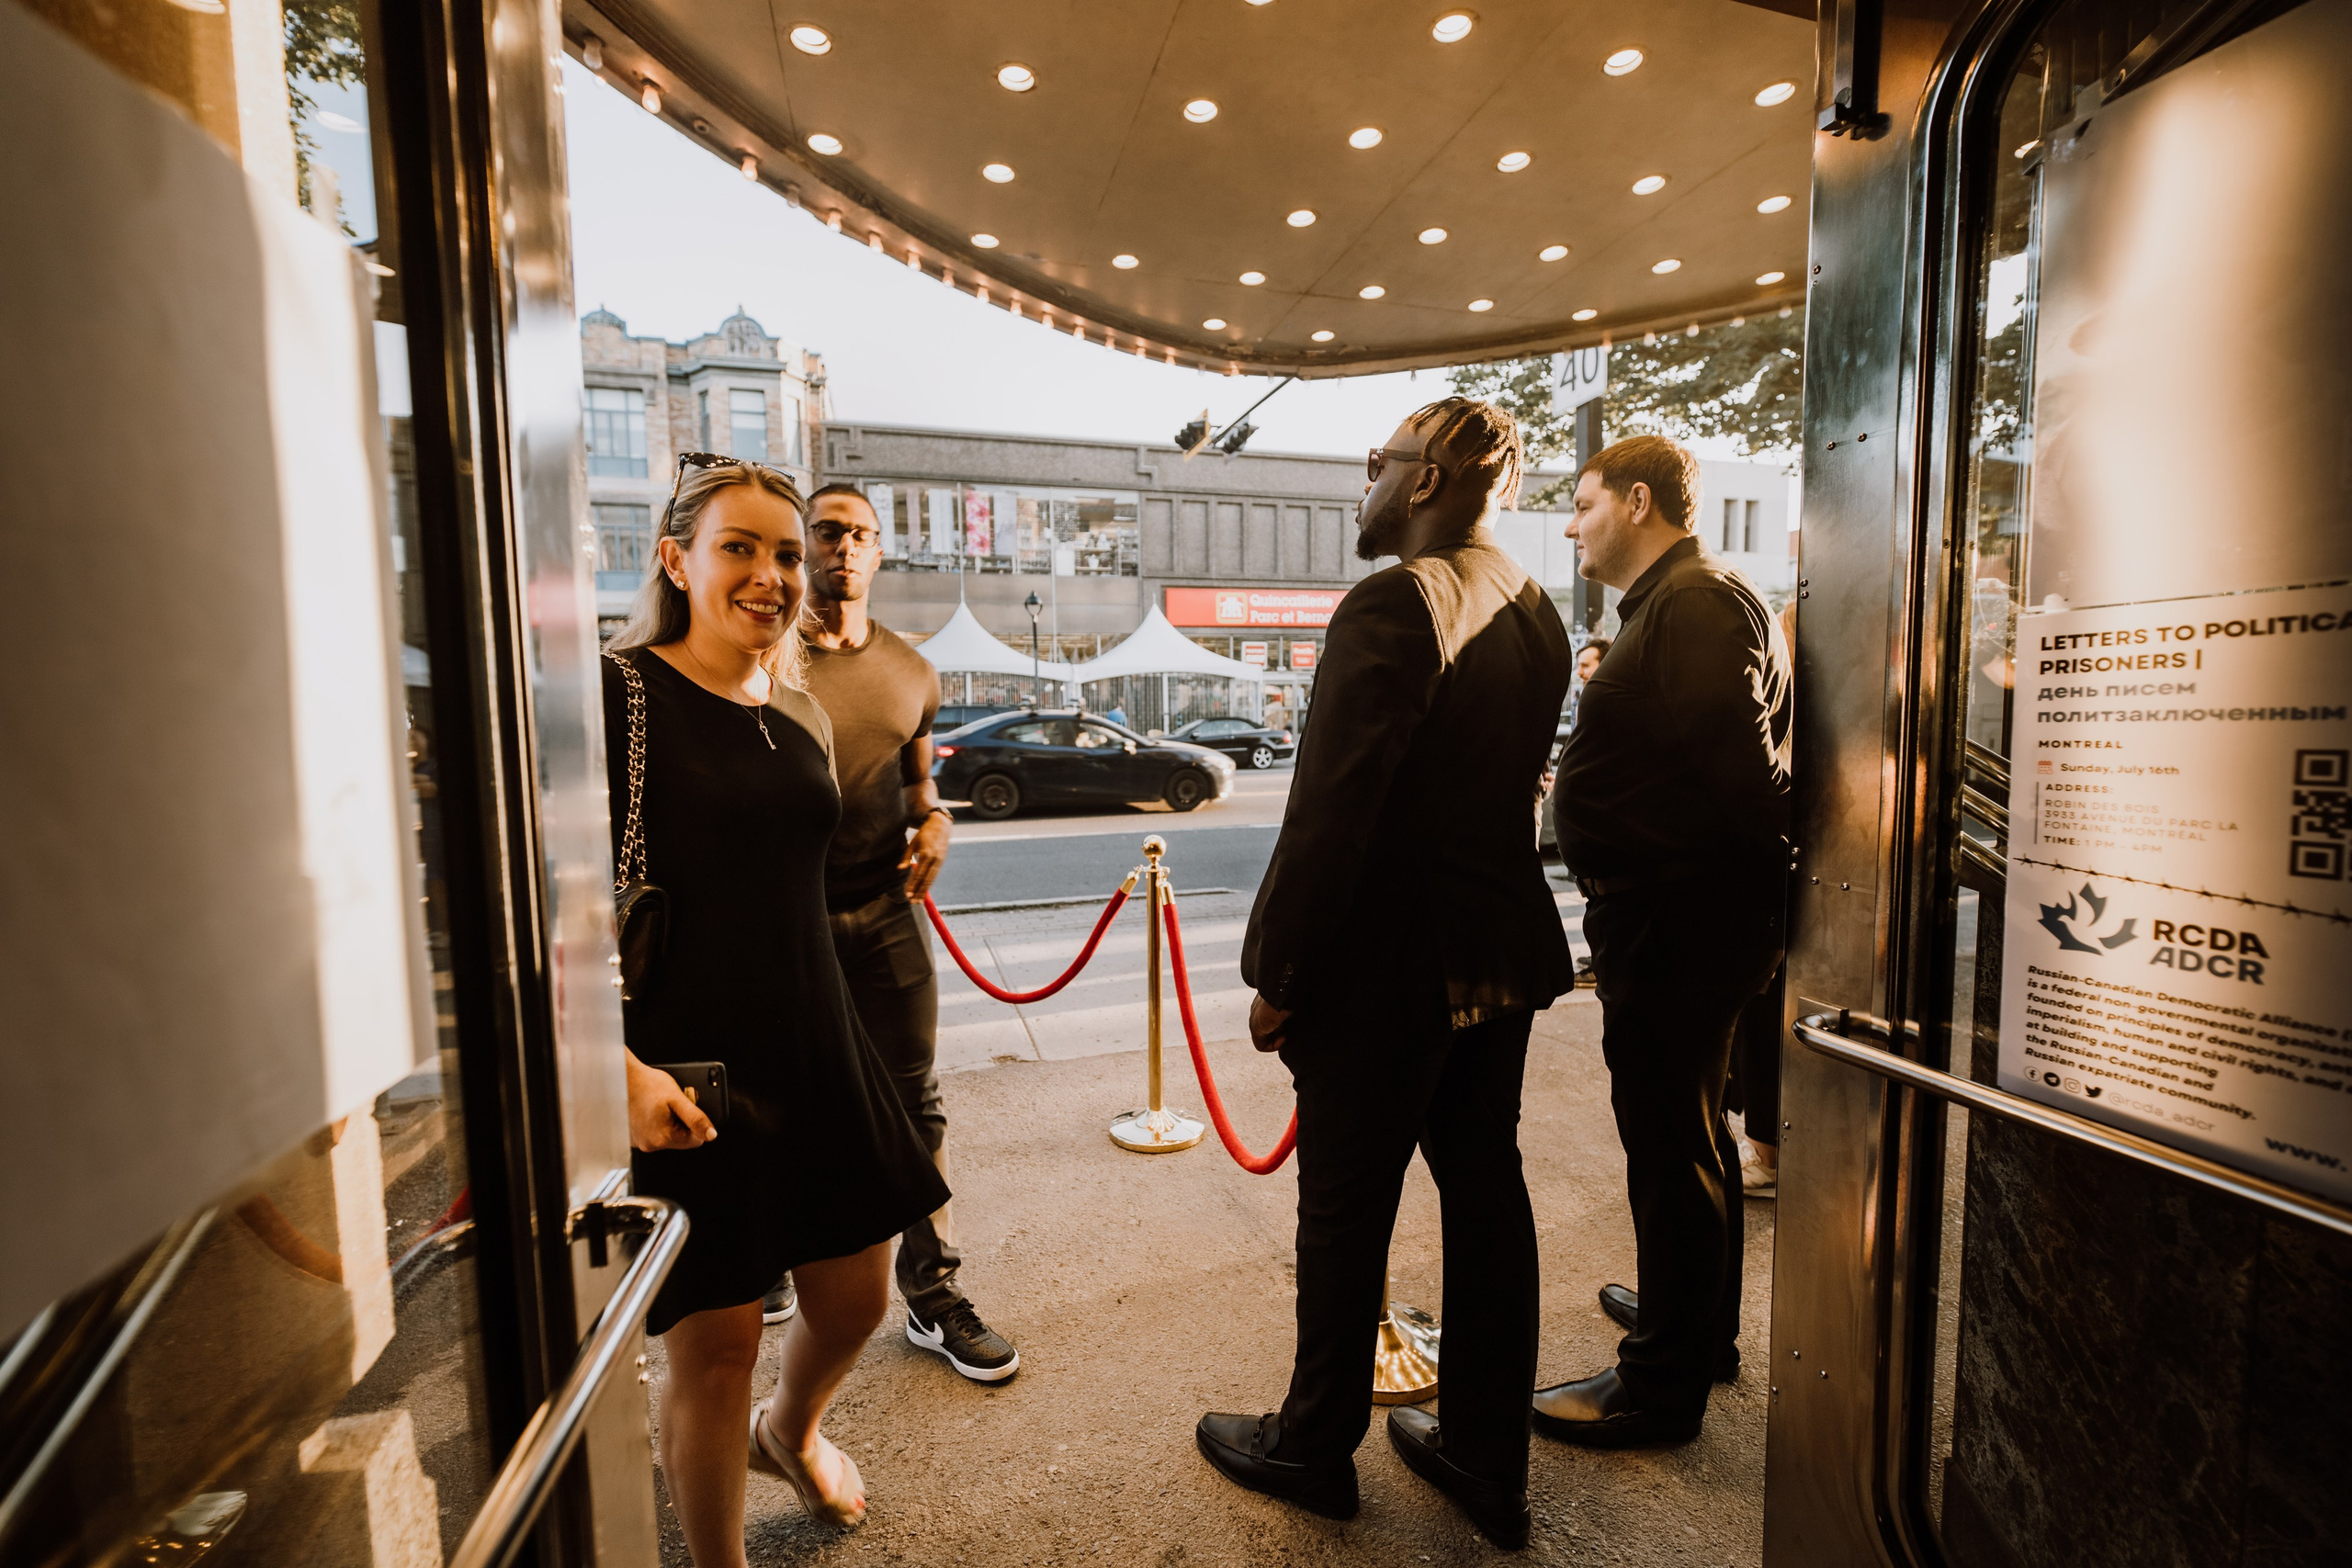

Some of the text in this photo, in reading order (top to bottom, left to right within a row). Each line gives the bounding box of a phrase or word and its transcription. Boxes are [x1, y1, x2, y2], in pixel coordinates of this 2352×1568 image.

[1560, 347, 1599, 391] 40
[1250, 593, 1333, 608] Quincaillerie
[1250, 610, 1280, 624] Parc
[1281, 611, 1295, 624] et
[2041, 628, 2148, 651] LETTERS
[2156, 625, 2196, 642] TO
[2040, 652, 2187, 675] PRISONERS
[2038, 682, 2196, 702] день писем
[2038, 705, 2347, 724] политзаключенным
[2038, 740, 2123, 750] MONTREAL
[2061, 762, 2180, 775] Sunday, July 16th
[2045, 784, 2114, 794] ADDRESS:
[2045, 799, 2160, 814] ROBIN DES BOIS
[2044, 821, 2117, 834] FONTAINE,
[2045, 810, 2076, 819] 3933
[2081, 812, 2136, 824] AVENUE
[2143, 816, 2163, 826] DU
[2168, 818, 2212, 829] PARC
[2043, 836, 2080, 846] TIME:
[2095, 840, 2115, 849] PM
[2132, 843, 2163, 852] 4PM
[2154, 919, 2271, 959] RCDA
[2149, 946, 2265, 986] ADCR
[2027, 964, 2154, 998] Russian-Canadian
[2156, 992, 2256, 1021] Democratic
[2259, 1013, 2338, 1038] Alliance
[2027, 978, 2039, 988] is
[2051, 984, 2101, 1002] federal
[2104, 998, 2255, 1037] non-governmental
[2027, 992, 2084, 1012] founded
[2086, 1007, 2104, 1018] on
[2107, 1012, 2183, 1036] principles
[2187, 1029, 2205, 1041] of
[2027, 1006, 2109, 1035] imperialism,
[2113, 1028, 2165, 1047] human
[2168, 1043, 2198, 1055] and
[2201, 1050, 2238, 1065] civil
[2303, 1076, 2343, 1091] and
[2027, 1020, 2220, 1078] at building and supporting
[2027, 1034, 2214, 1091] the Russian-Canadian and
[2025, 1047, 2256, 1121] Russian expatriate community.
[2264, 1136, 2348, 1172] www.
